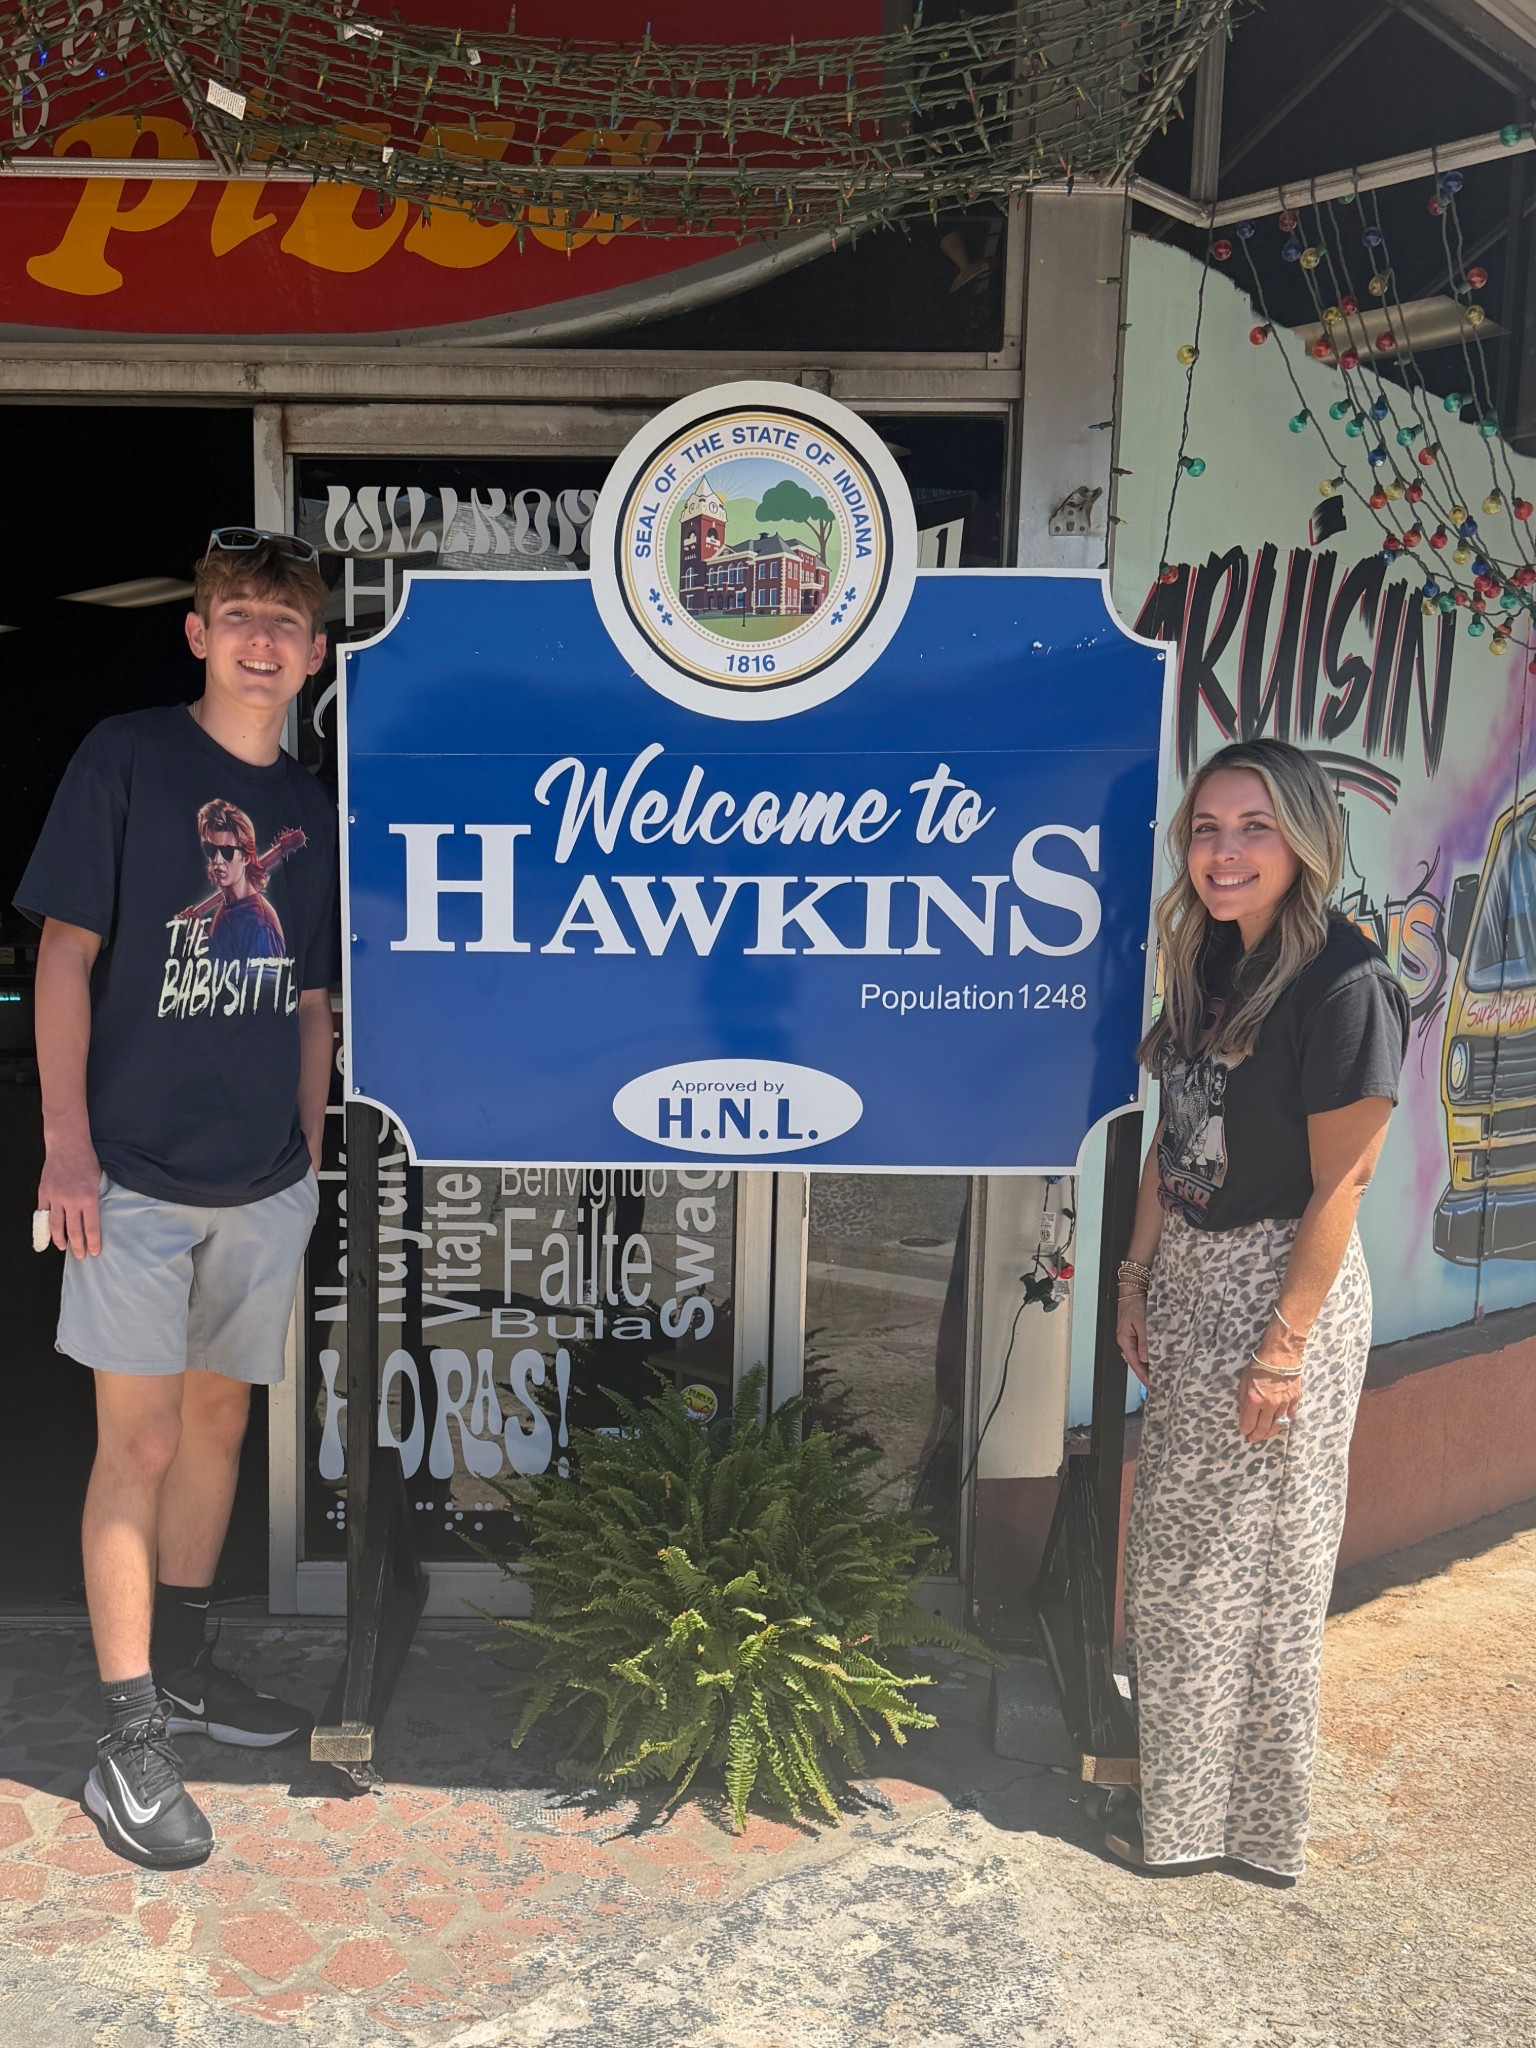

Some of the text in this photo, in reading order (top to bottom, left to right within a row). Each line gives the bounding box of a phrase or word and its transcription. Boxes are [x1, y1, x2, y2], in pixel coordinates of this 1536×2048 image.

[634, 426, 872, 560] SEAL OF THE STATE OF INDIANA
[726, 654, 776, 674] 1816
[534, 742, 996, 864] Welcome to
[389, 823, 1102, 957] HAWKINS
[166, 917, 213, 958] THE
[658, 1098, 819, 1140] H.N.L.
[672, 1080, 785, 1094] Approved by
[421, 1173, 498, 1329] Vitajte
[504, 1208, 653, 1307] Fáilte
[491, 1308, 653, 1340] Bula
